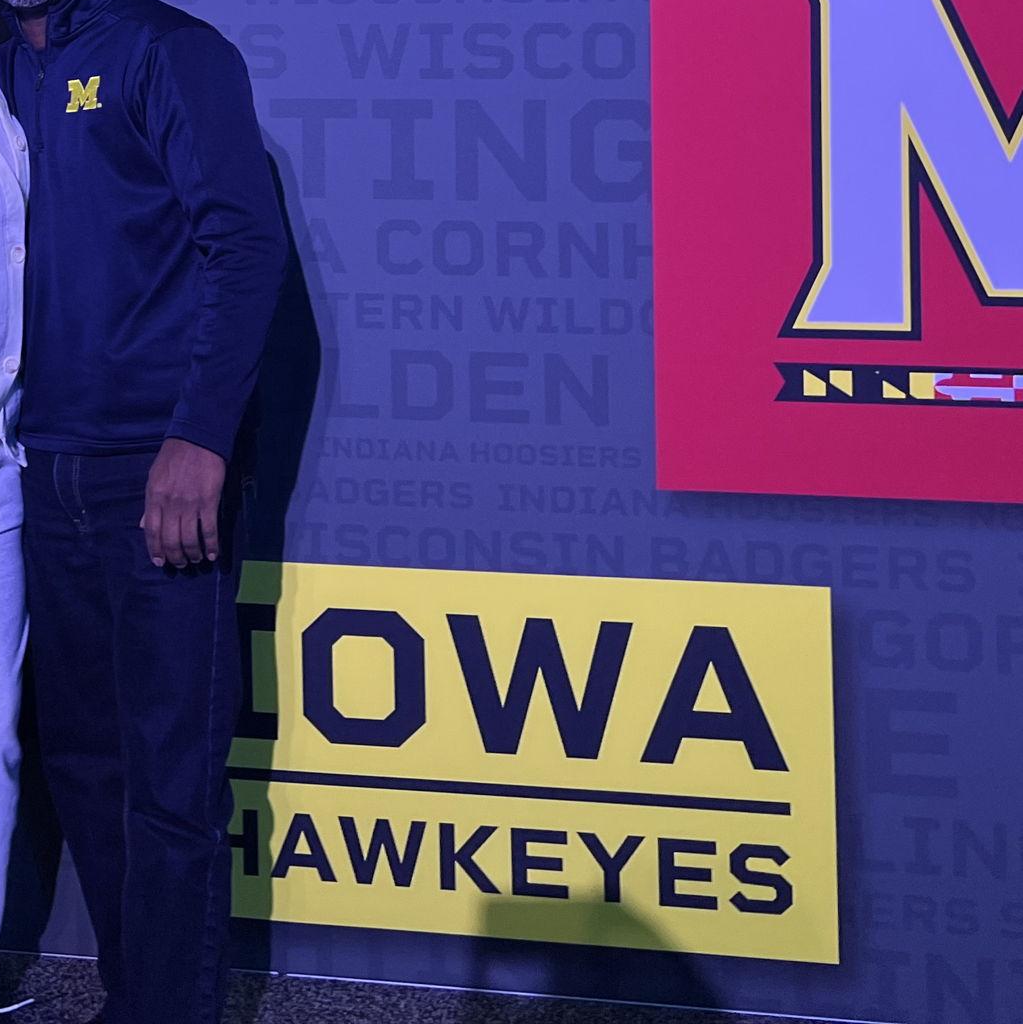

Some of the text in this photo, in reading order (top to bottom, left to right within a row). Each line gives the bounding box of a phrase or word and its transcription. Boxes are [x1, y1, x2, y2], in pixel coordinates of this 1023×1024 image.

[66, 76, 100, 113] M
[470, 441, 642, 470] HOOSIERS
[650, 536, 976, 593] BADGERS
